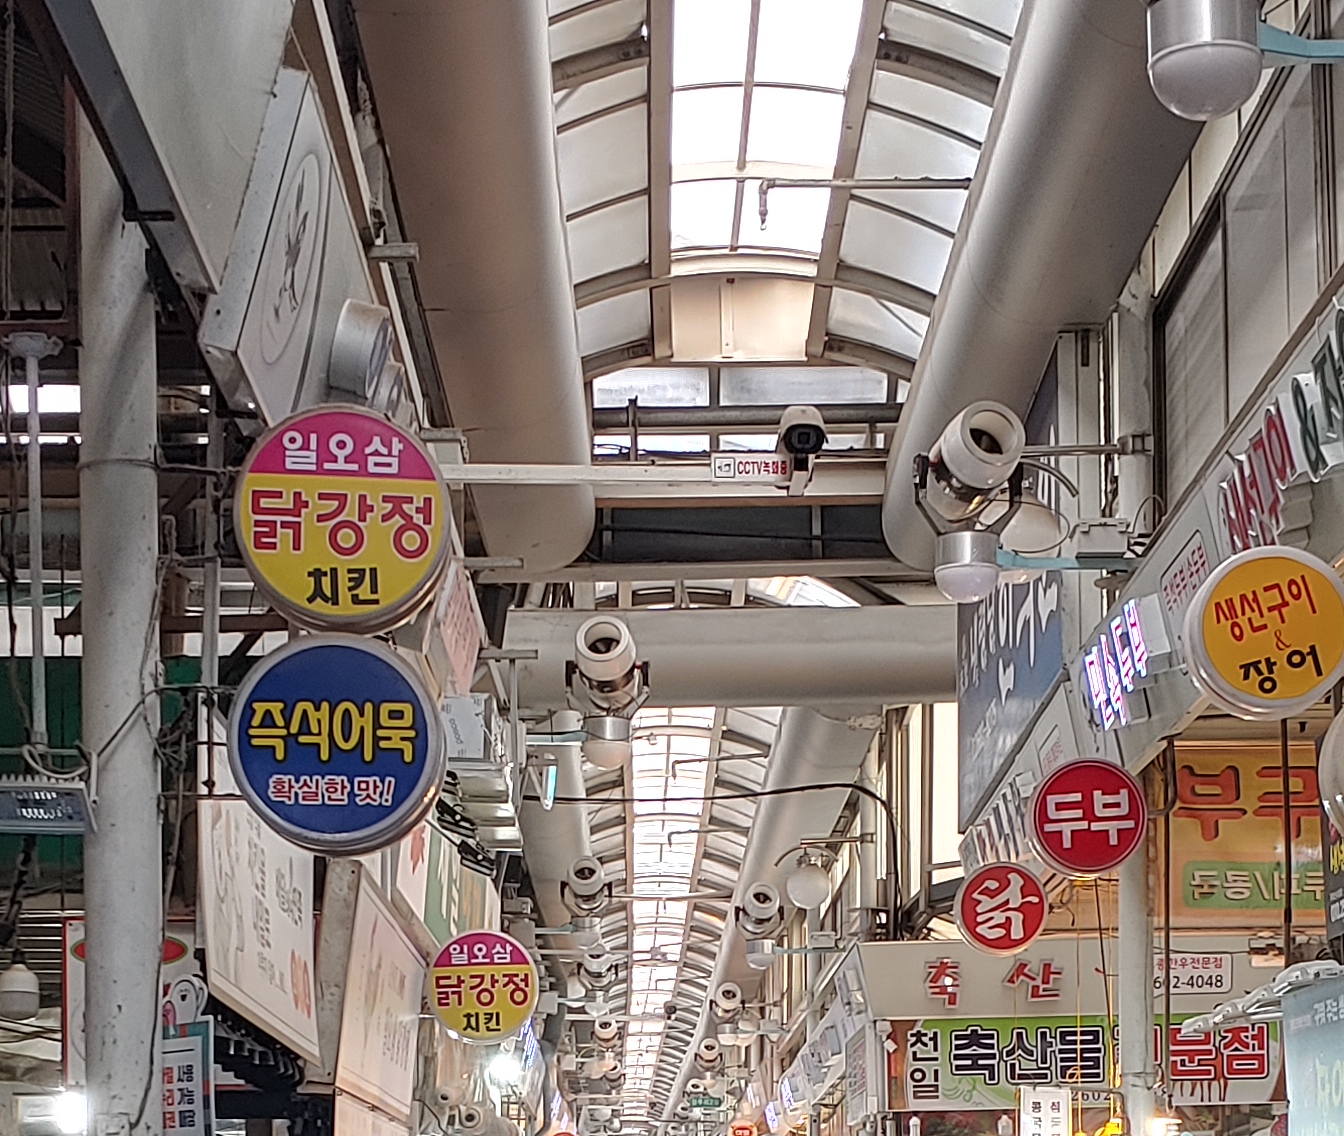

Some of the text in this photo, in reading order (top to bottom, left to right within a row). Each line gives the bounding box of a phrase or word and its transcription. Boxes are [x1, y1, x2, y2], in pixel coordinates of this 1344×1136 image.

[281, 431, 403, 472] 일오삼
[251, 487, 434, 560] 닭강정
[306, 564, 380, 605] 치킨
[1214, 575, 1317, 641] 생선구이
[1275, 629, 1292, 651] &
[1239, 644, 1324, 693] 장어
[247, 700, 417, 764] 즉석어묵
[270, 776, 395, 805] 확실한 맛!
[1042, 787, 1136, 848] 두부
[972, 874, 1039, 942] 닭
[449, 943, 512, 964] 일오삼
[435, 974, 530, 1009] 닭강정
[463, 1012, 502, 1033] 치킨
